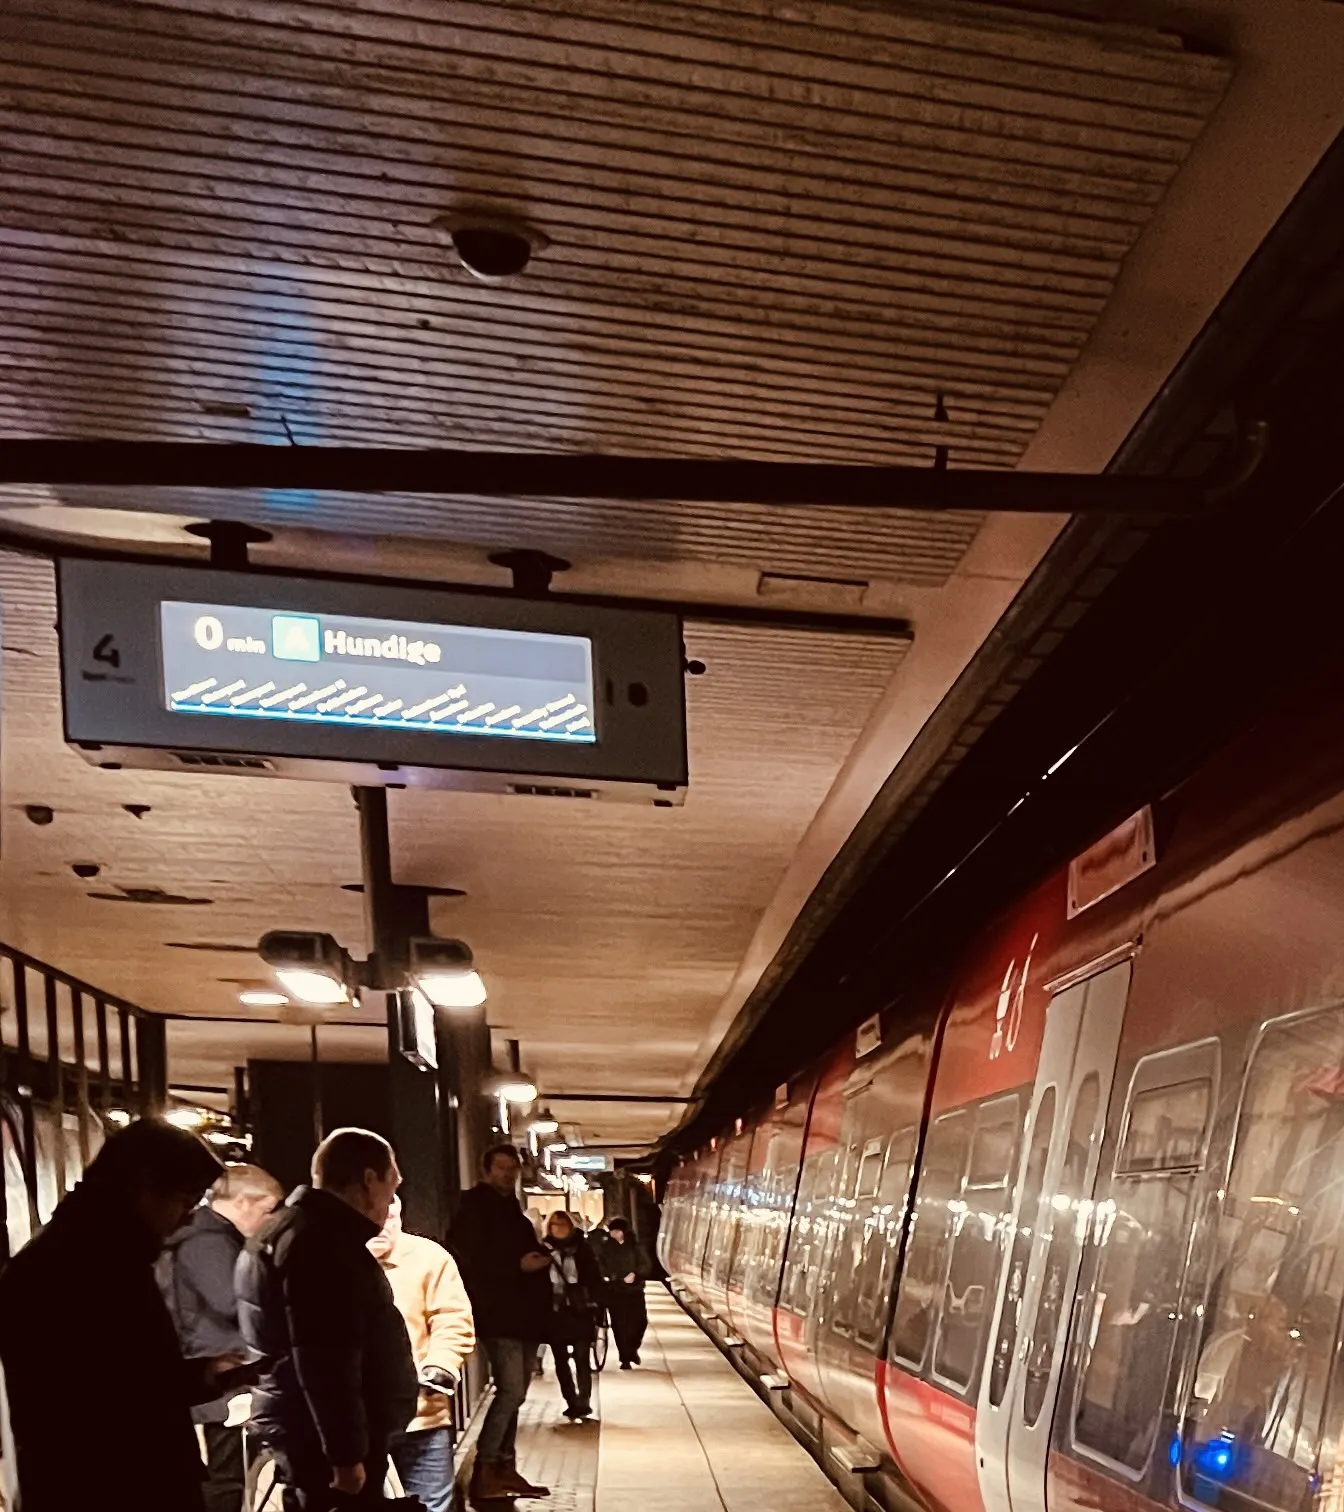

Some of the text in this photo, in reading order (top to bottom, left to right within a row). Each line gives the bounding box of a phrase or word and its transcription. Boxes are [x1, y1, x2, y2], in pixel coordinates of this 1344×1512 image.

[93, 633, 120, 668] 4
[194, 615, 224, 650] 0
[227, 636, 266, 655] min
